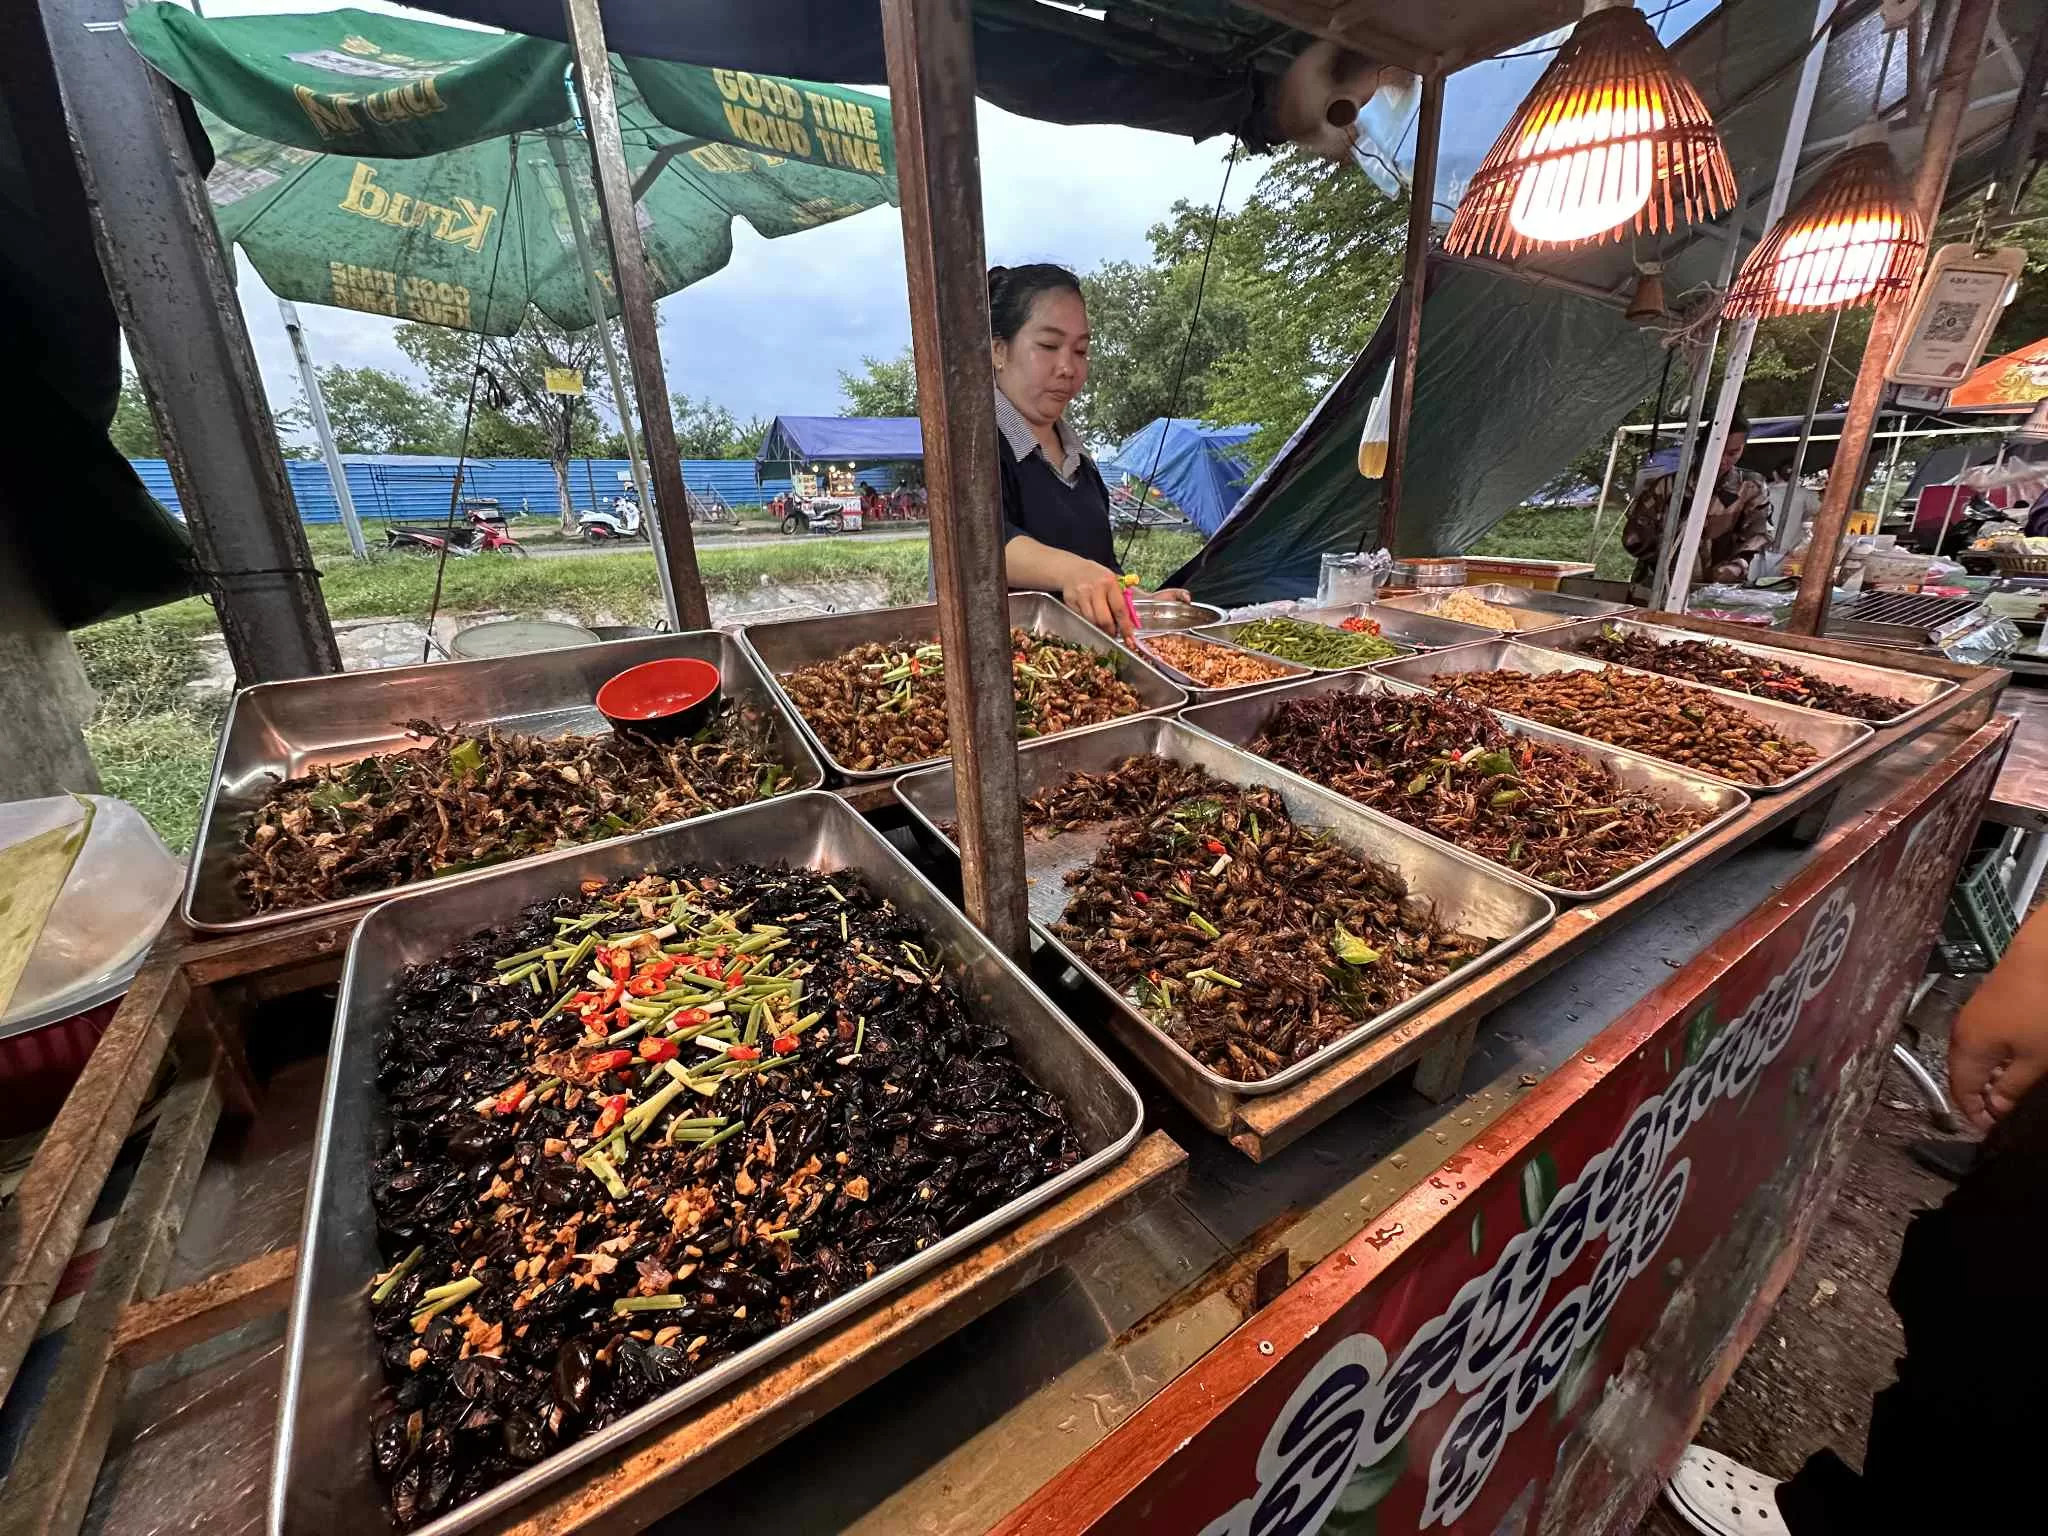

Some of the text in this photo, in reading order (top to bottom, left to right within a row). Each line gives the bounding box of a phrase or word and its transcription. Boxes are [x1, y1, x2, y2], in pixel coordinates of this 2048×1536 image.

[712, 68, 878, 142] GOOD TIME
[722, 100, 813, 157] KRUD
[815, 126, 886, 176] TIME
